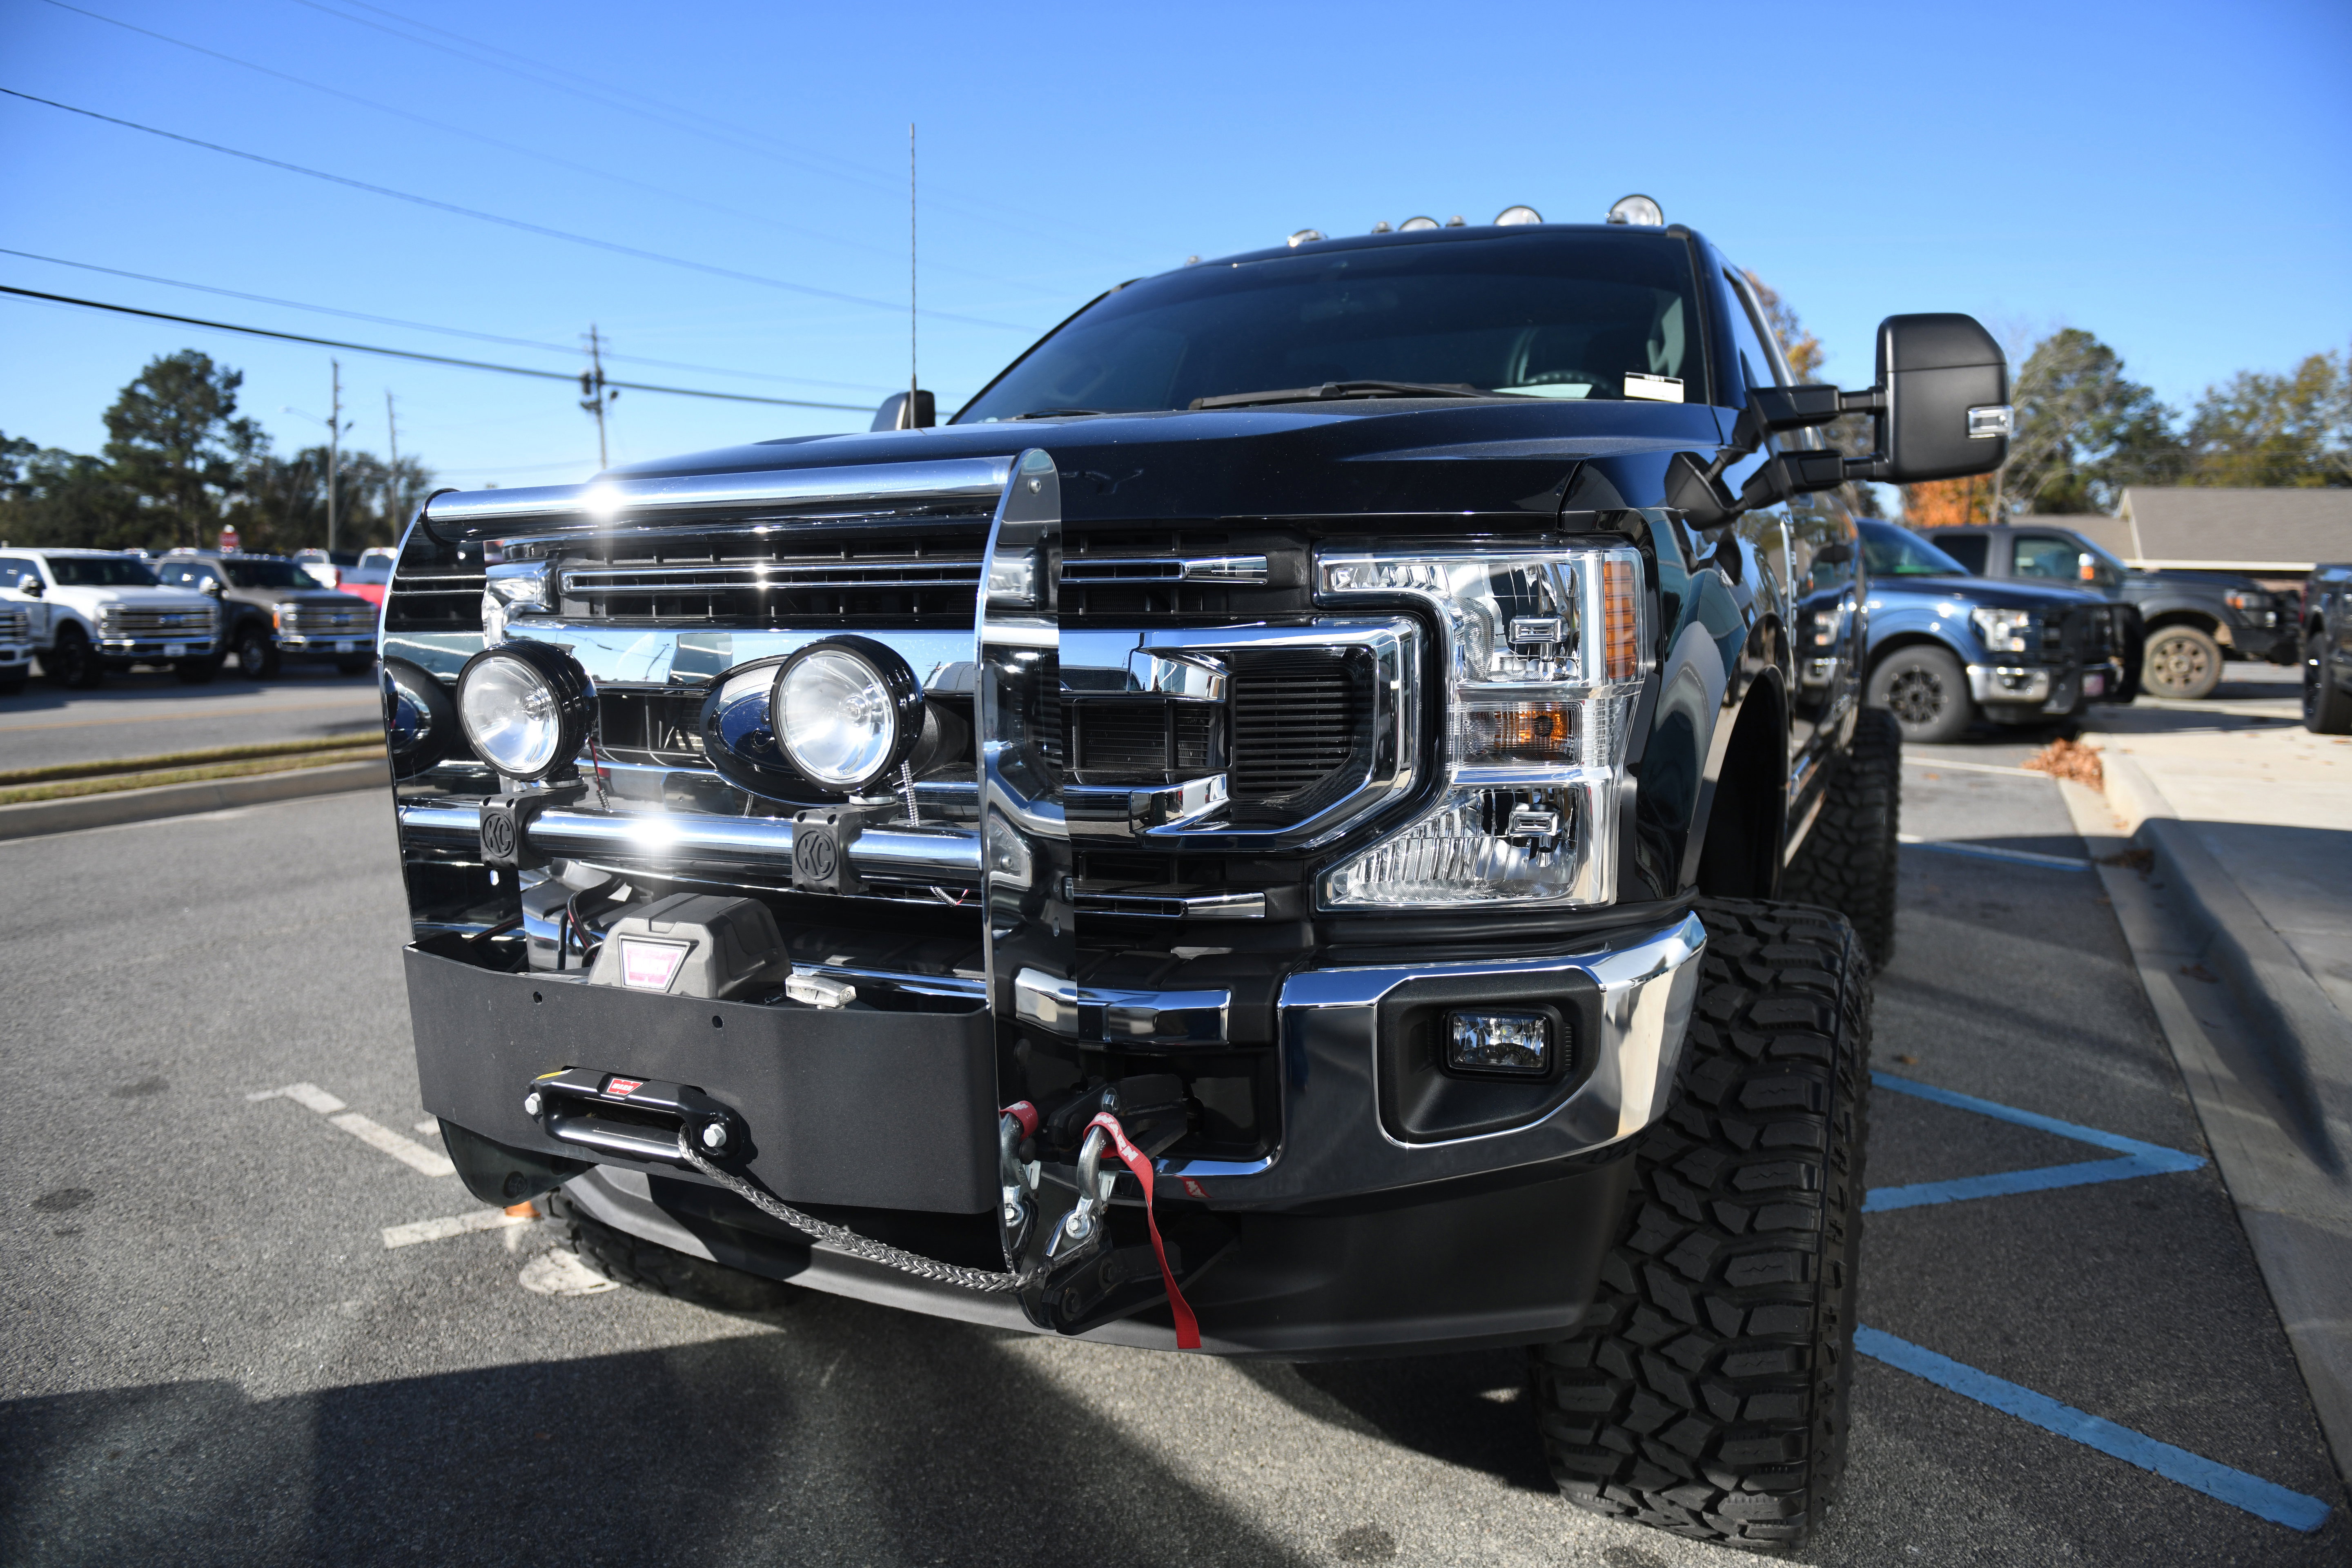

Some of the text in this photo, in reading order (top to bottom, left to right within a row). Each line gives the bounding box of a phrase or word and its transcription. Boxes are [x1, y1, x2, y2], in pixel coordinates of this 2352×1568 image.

[486, 816, 511, 853] KC
[802, 834, 831, 875] KC
[611, 1083, 634, 1091] WARN
[1094, 1114, 1139, 1162] WARN
